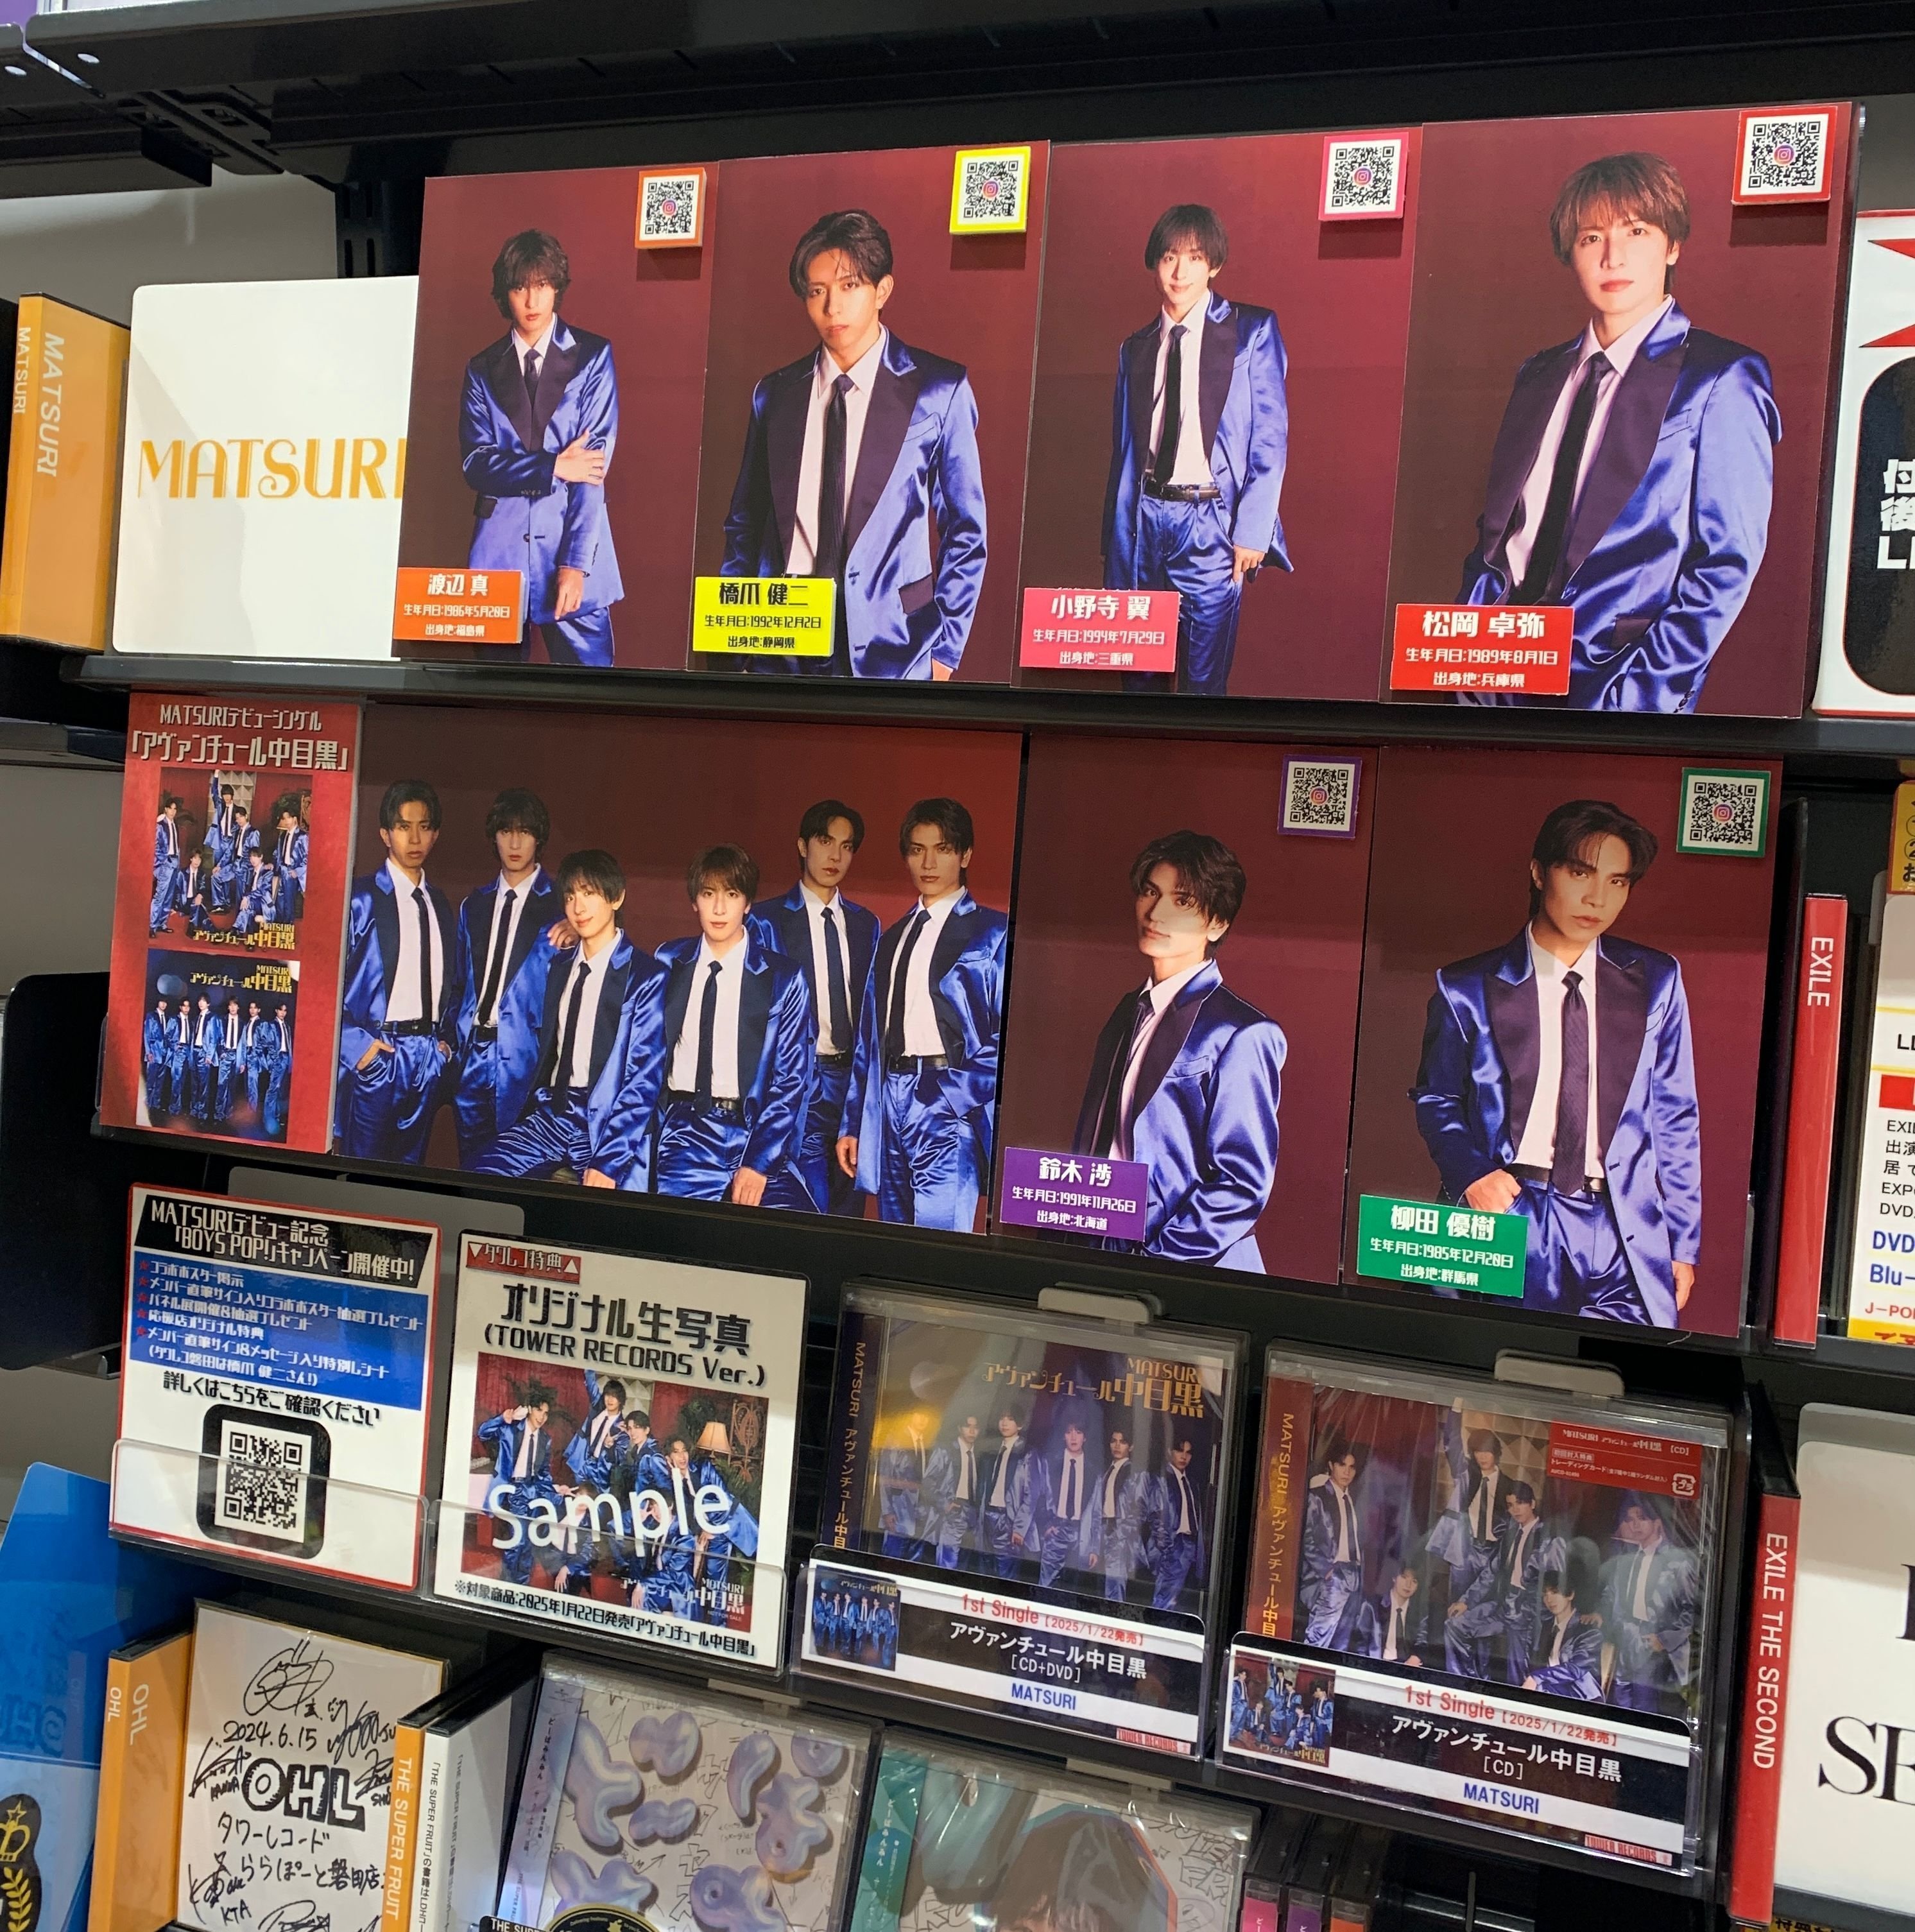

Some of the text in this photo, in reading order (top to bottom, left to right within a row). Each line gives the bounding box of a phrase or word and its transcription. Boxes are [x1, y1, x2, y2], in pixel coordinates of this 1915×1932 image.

[13, 327, 31, 414] MATSURI
[37, 332, 65, 478] MATSURI
[137, 438, 407, 499] MATSURI
[1877, 535, 1915, 569] L
[427, 573, 488, 596] 渡辺 真
[767, 583, 808, 607] 健二
[705, 614, 822, 630] 生年月日:1992年12月2日
[1051, 595, 1151, 621] 小野寺 翼
[425, 623, 485, 638] 出身地:福島県
[1033, 628, 1165, 646] 生年月日:1994年7月29日
[1422, 611, 1545, 639] 松岡 卓弥
[727, 635, 796, 650] 出身地:静岡県
[1059, 650, 1134, 666] 出身地:三重県
[1405, 647, 1559, 666] 生年月日:1989年8月1日
[1432, 671, 1525, 689] 出身地:兵庫県
[256, 965, 289, 976] MATSUR
[1807, 936, 1834, 1007] EXILE
[1887, 1119, 1915, 1134] EXI
[1039, 1156, 1083, 1184] 鈴木
[1882, 1182, 1915, 1196] EXP
[151, 1200, 329, 1248] MATSURIデビュー記念
[1036, 1210, 1108, 1231] 出身地:北海道
[1391, 1205, 1495, 1243] 柳田 優樹
[1400, 1264, 1479, 1288] 出身地:群馬県
[500, 1283, 751, 1356] オリジナル生写真
[1865, 1302, 1915, 1320] J-PO
[485, 1323, 765, 1387] (TOWER RECORDS Ver.)
[1128, 1358, 1198, 1383] MATSUR
[849, 1342, 866, 1418] MATSURI
[1276, 1413, 1294, 1494] MATSURI
[962, 1593, 985, 1615] 1st
[990, 1600, 1039, 1626] Single
[949, 1621, 1147, 1680] アヴァンチュール中目黒
[1753, 1532, 1788, 1770] EXILE THE SECOND
[107, 1686, 122, 1722] OHL
[1011, 1683, 1076, 1711] MATSURI
[1404, 1684, 1433, 1707] 1st
[1439, 1692, 1495, 1721] Single
[130, 1684, 149, 1746] OHL
[224, 1720, 317, 1752] 2024.6.15
[1392, 1715, 1622, 1782] アヴァンチュール中目黒
[241, 1757, 365, 1831] OHL
[427, 1789, 437, 1822] SUPER
[1463, 1783, 1540, 1815] MATSURI
[218, 1811, 330, 1854] タワーレコード
[385, 1757, 413, 1920] THE SUPER FRUIT
